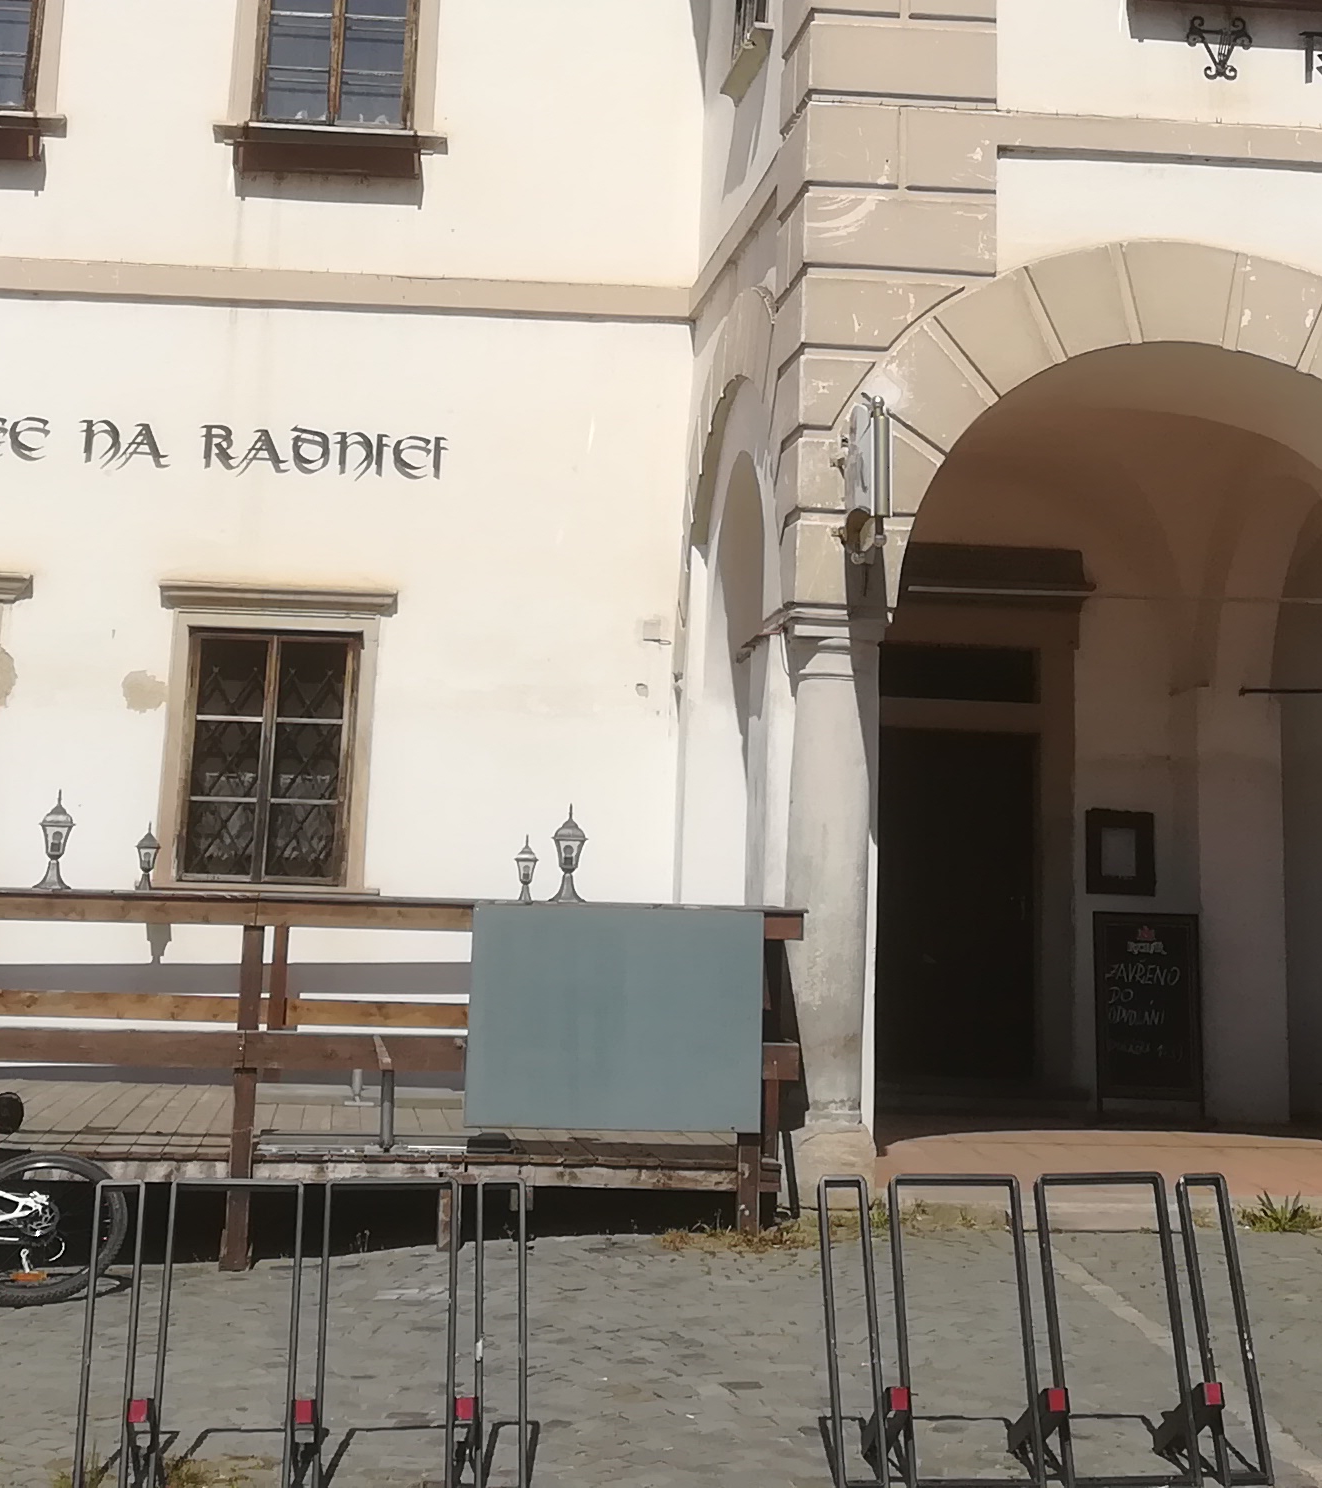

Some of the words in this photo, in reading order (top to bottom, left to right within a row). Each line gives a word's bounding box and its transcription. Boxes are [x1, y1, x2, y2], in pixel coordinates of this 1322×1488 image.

[83, 419, 170, 471] NA
[201, 424, 449, 482] RADNICI
[1105, 959, 1181, 986] ZAVŘENO
[1108, 986, 1134, 1004] DO
